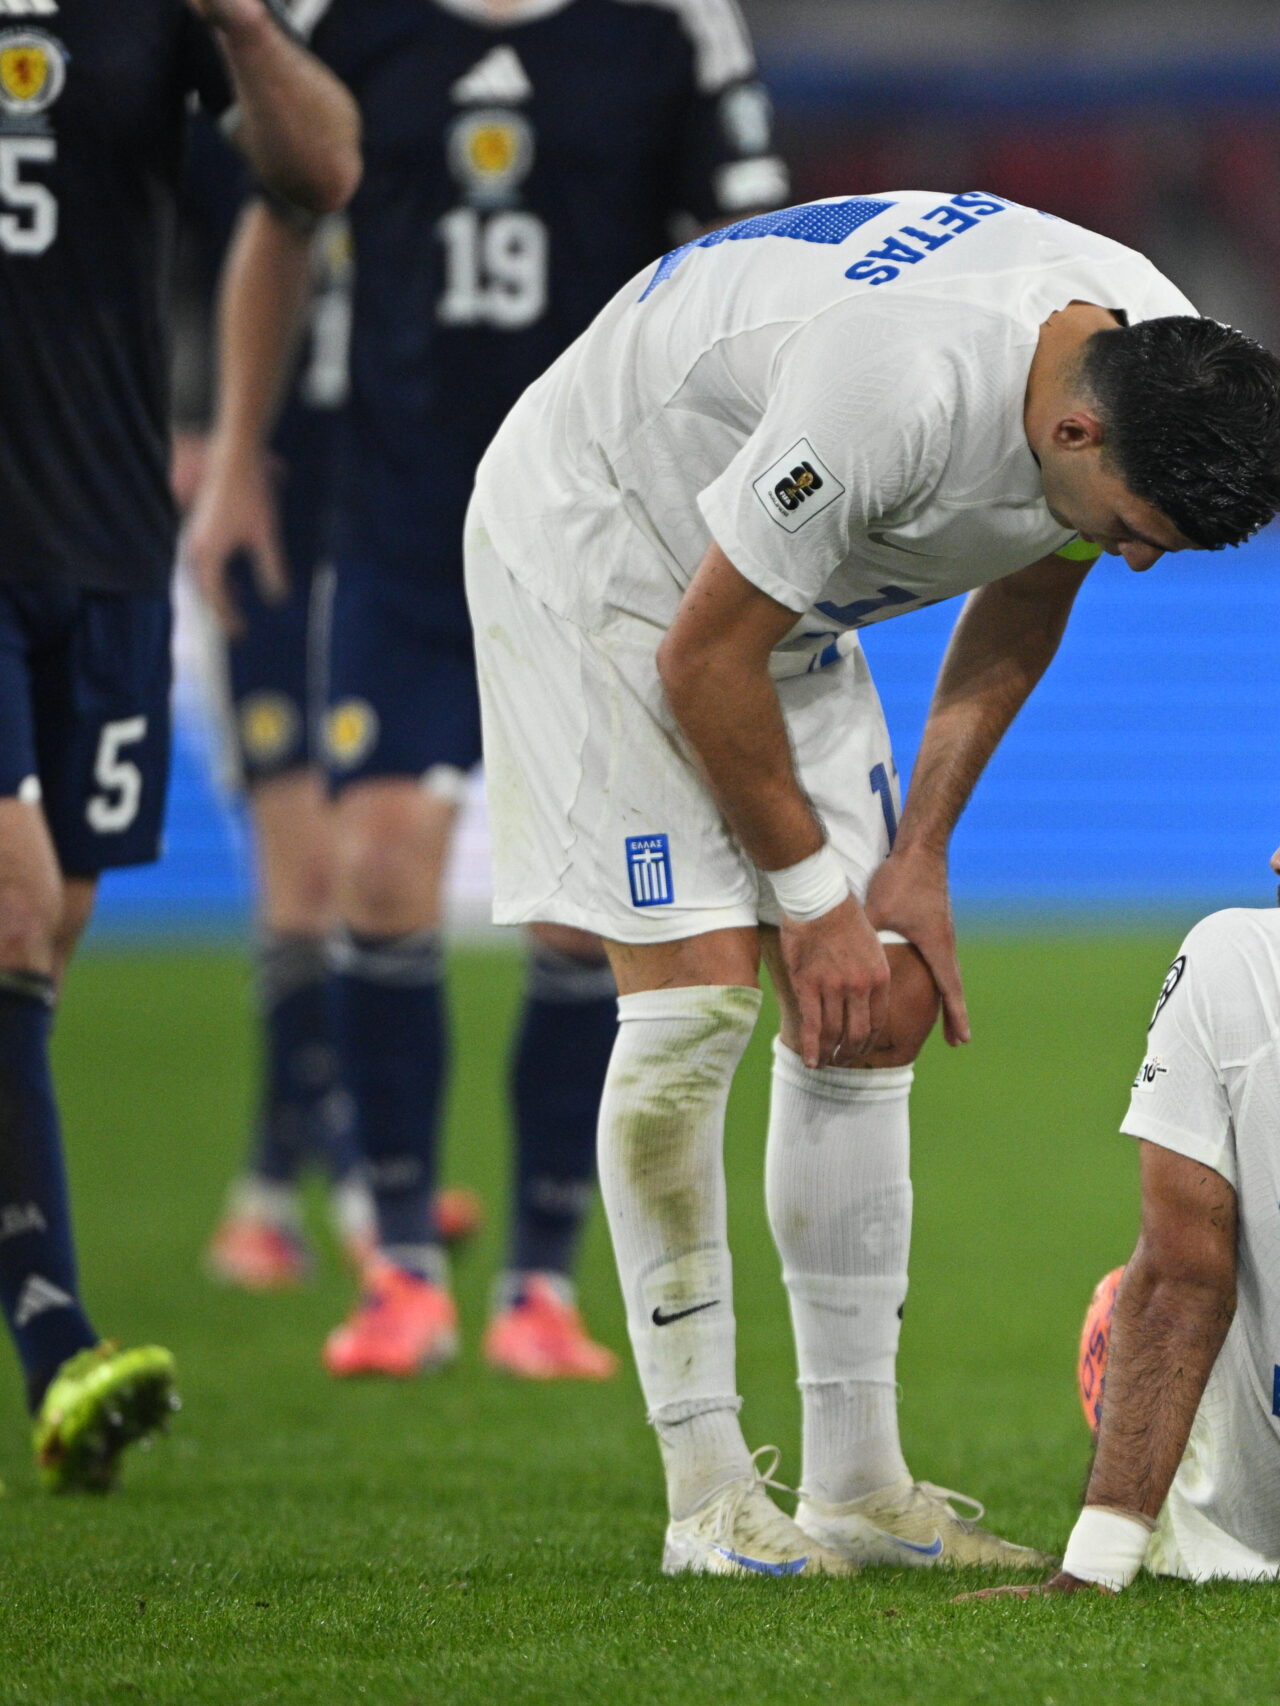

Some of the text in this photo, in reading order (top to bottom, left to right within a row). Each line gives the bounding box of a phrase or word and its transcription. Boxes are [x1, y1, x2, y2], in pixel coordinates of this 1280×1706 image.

[0, 136, 57, 254] 5
[844, 190, 1012, 286] SETAS
[436, 210, 548, 328] 19
[779, 490, 792, 506] FIFA
[86, 716, 148, 832] 5
